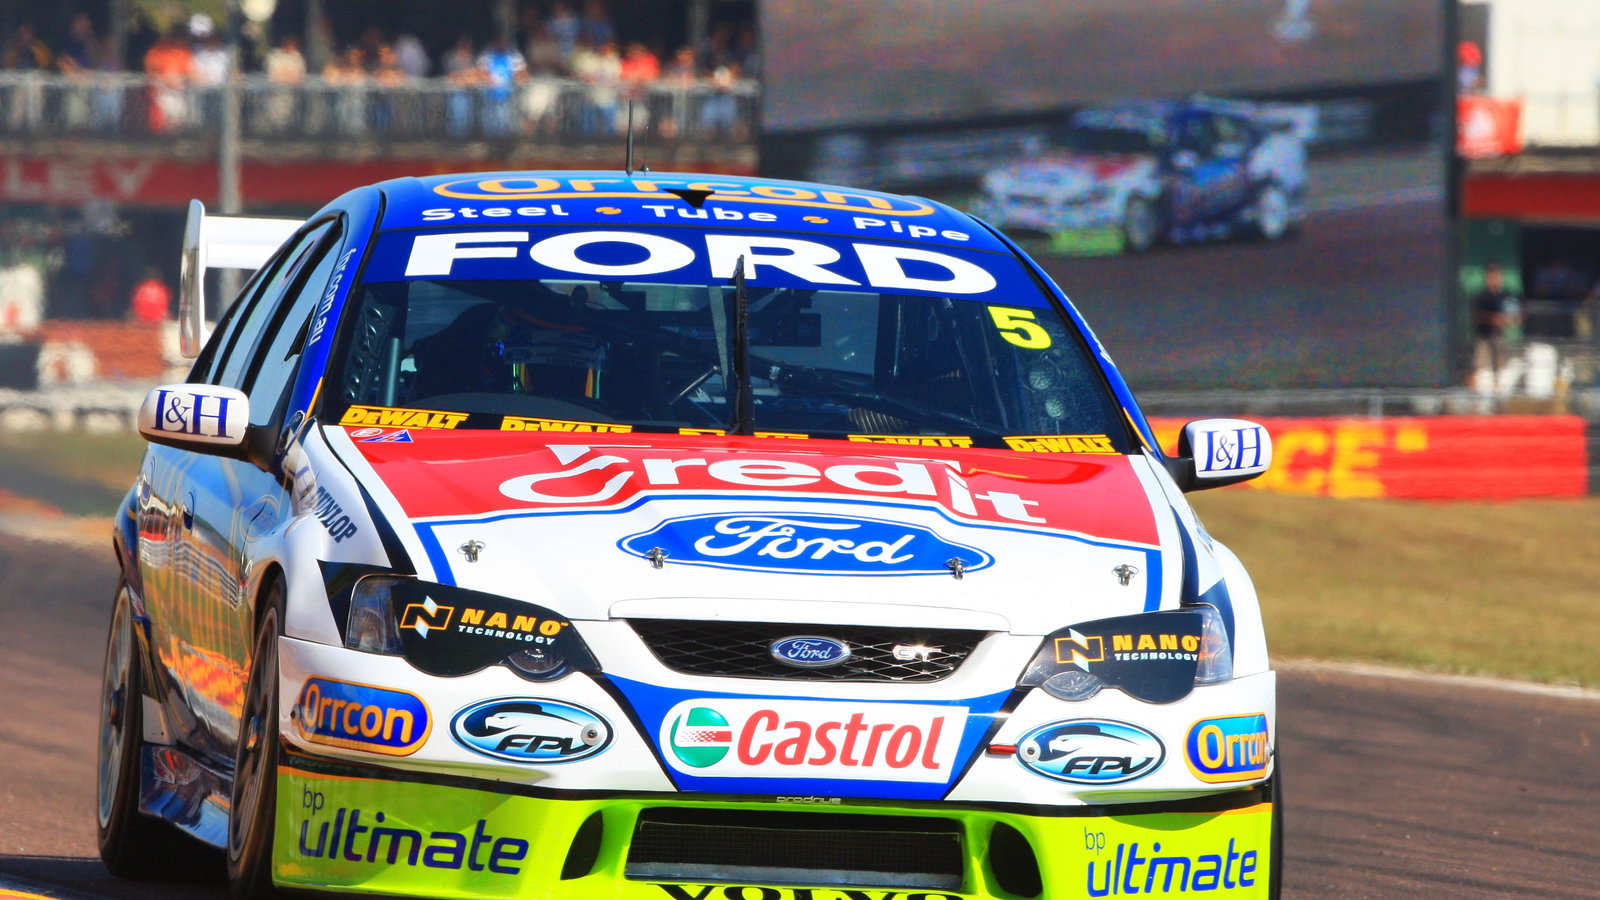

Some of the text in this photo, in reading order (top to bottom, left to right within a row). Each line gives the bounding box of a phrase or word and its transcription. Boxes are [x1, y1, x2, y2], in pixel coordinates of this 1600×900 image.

[477, 178, 893, 210] Orrcon
[421, 204, 971, 242] Steel Tube Pipe
[404, 231, 997, 294] FORD
[987, 306, 1052, 350] 5
[151, 389, 237, 439] L&H
[1199, 426, 1264, 472] L&H
[694, 516, 916, 564] Ford
[458, 625, 556, 646] TECHNOLOGY
[787, 640, 833, 660] Ford
[1114, 652, 1198, 662] TECHNOLOGY
[303, 683, 415, 744] Orrcon
[496, 733, 590, 755] FPV
[737, 709, 945, 769] Castrol
[1061, 755, 1155, 775] FPV
[303, 784, 325, 815] bp
[299, 807, 530, 876] ultimate
[1084, 826, 1106, 856] bp
[1087, 837, 1258, 898] ultimate
